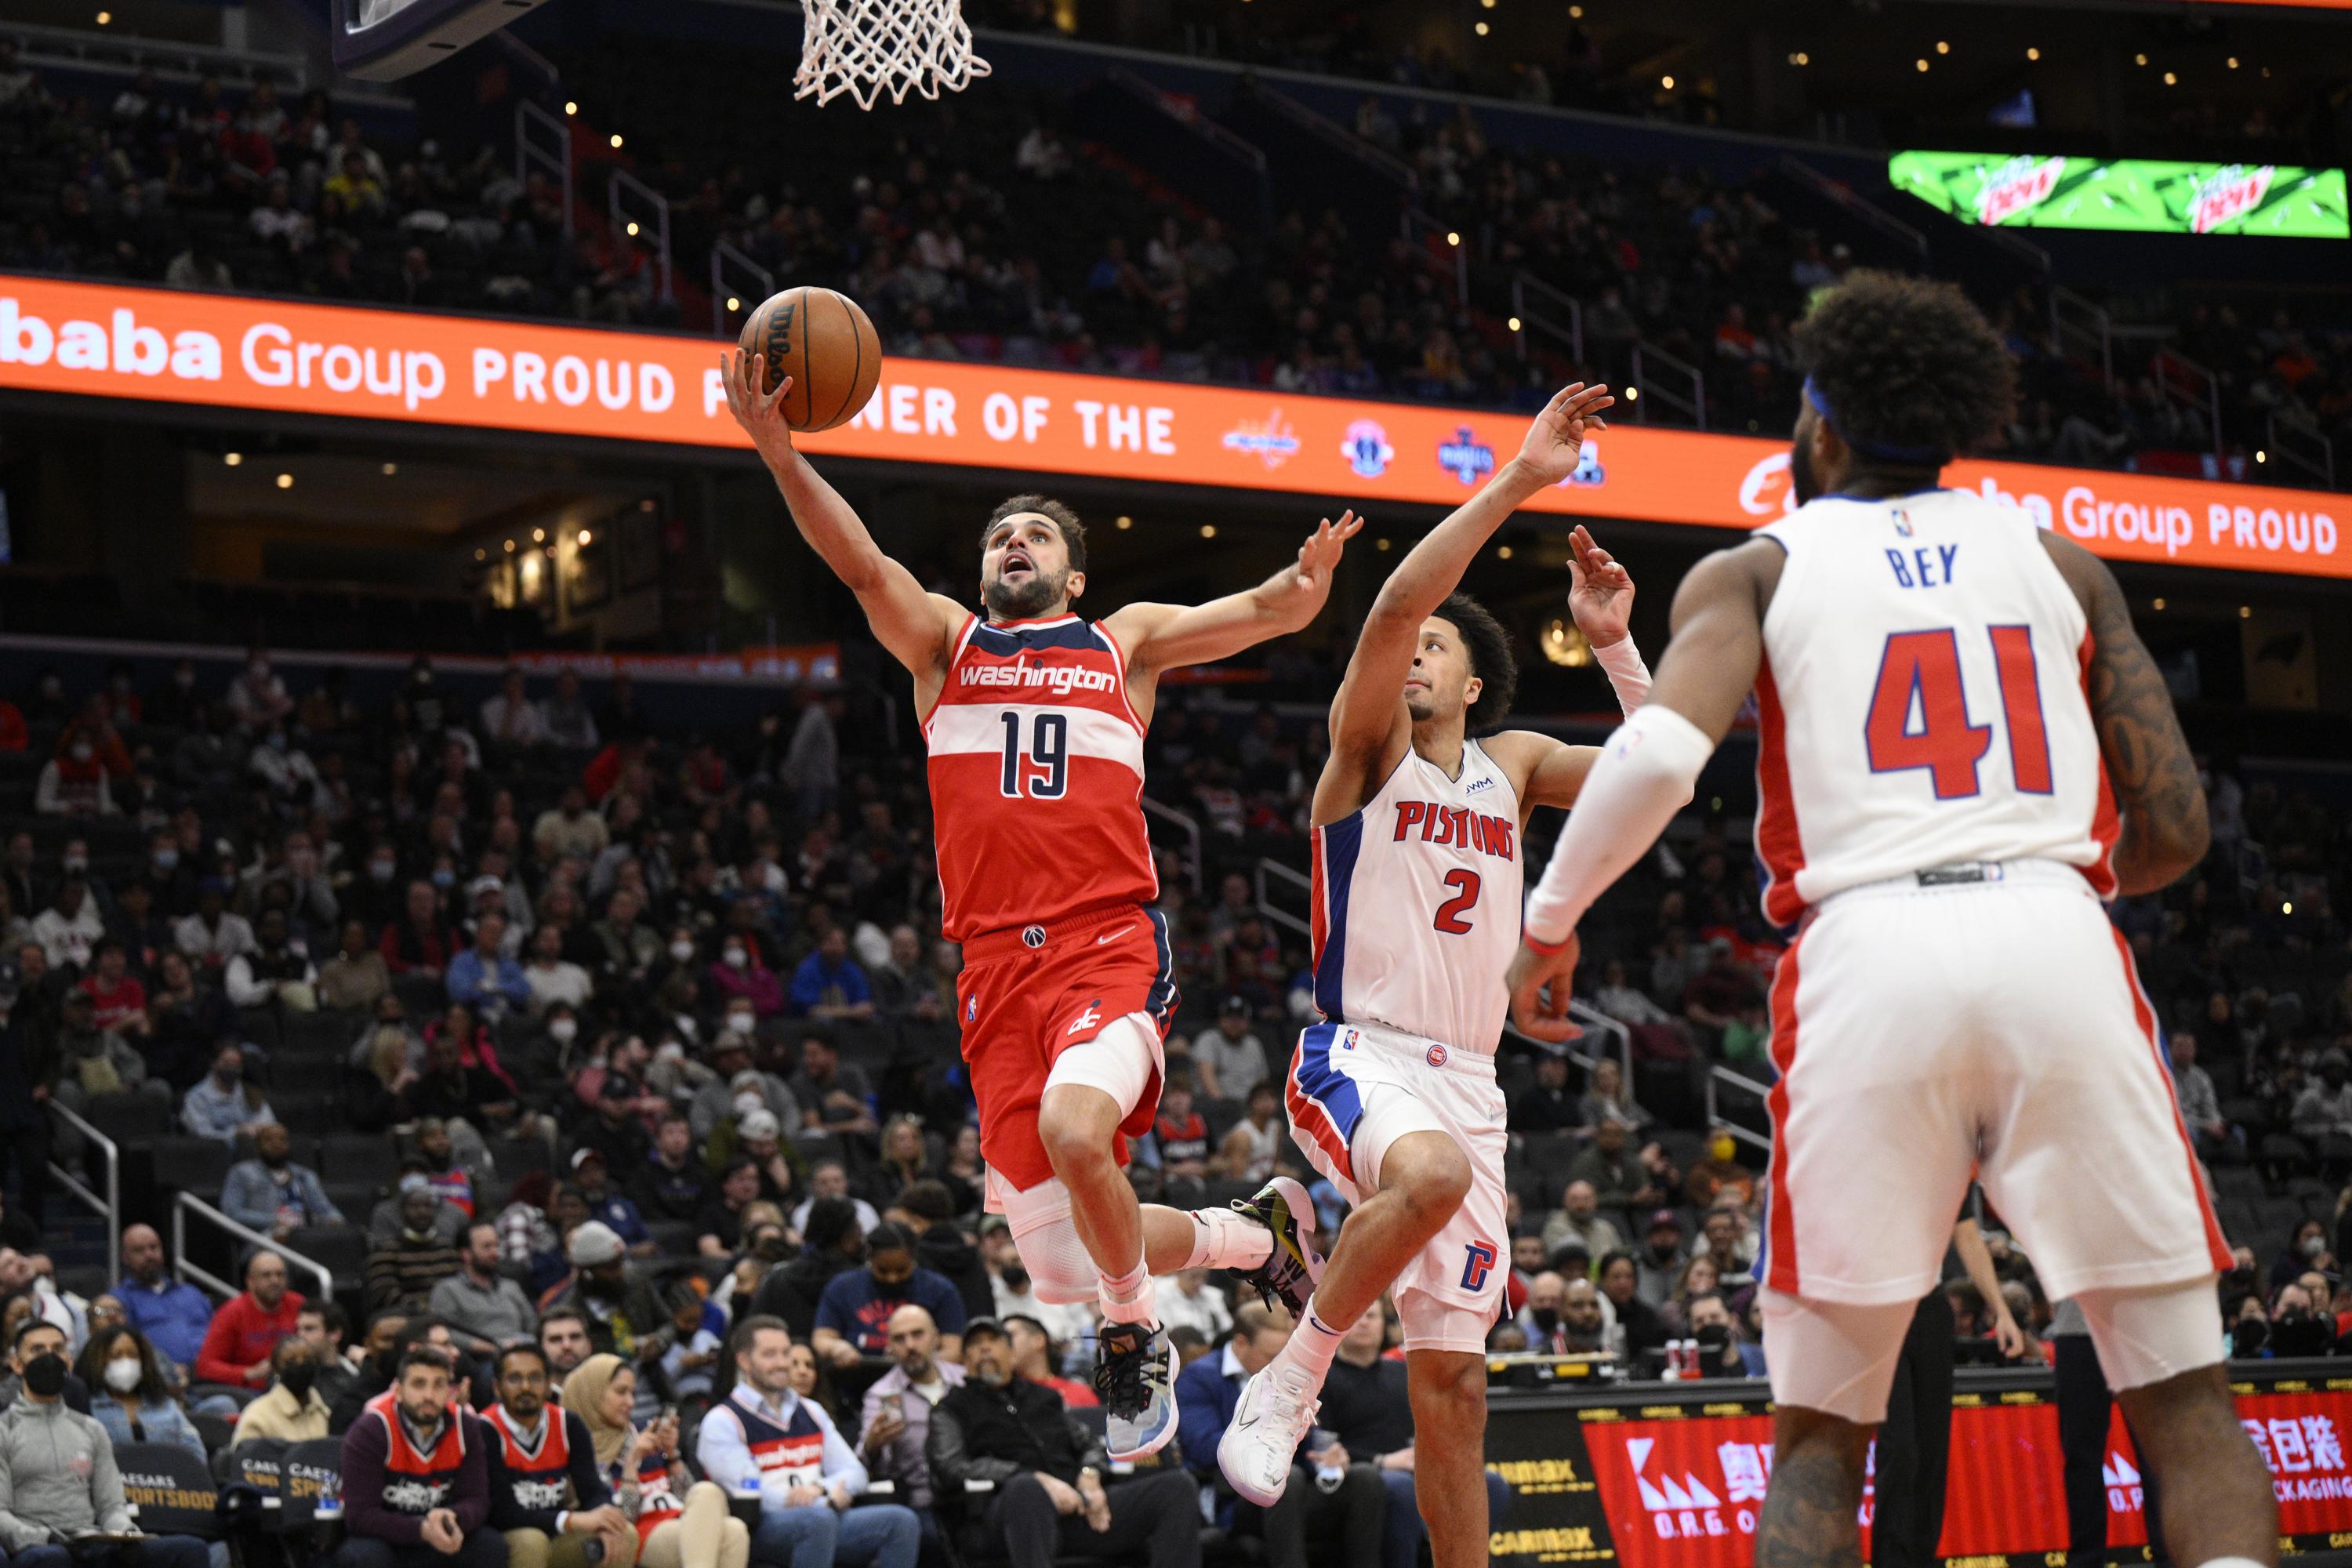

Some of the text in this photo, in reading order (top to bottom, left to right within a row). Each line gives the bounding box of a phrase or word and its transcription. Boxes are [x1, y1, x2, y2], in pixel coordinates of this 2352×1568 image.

[767, 303, 796, 390] Wilso
[241, 322, 446, 411] Group
[473, 348, 675, 413] PROUD
[983, 392, 1051, 443] OF
[1074, 401, 1176, 456] THE
[2062, 486, 2193, 556] Group
[2208, 503, 2337, 554] PROUD
[1885, 543, 1958, 588] BEY
[960, 655, 1116, 695] washington
[1865, 624, 2054, 800] 41
[1000, 710, 1069, 800] 19
[1393, 801, 1513, 862] PISTONS
[1433, 868, 1481, 935] 2
[119, 1472, 176, 1489] AESARS
